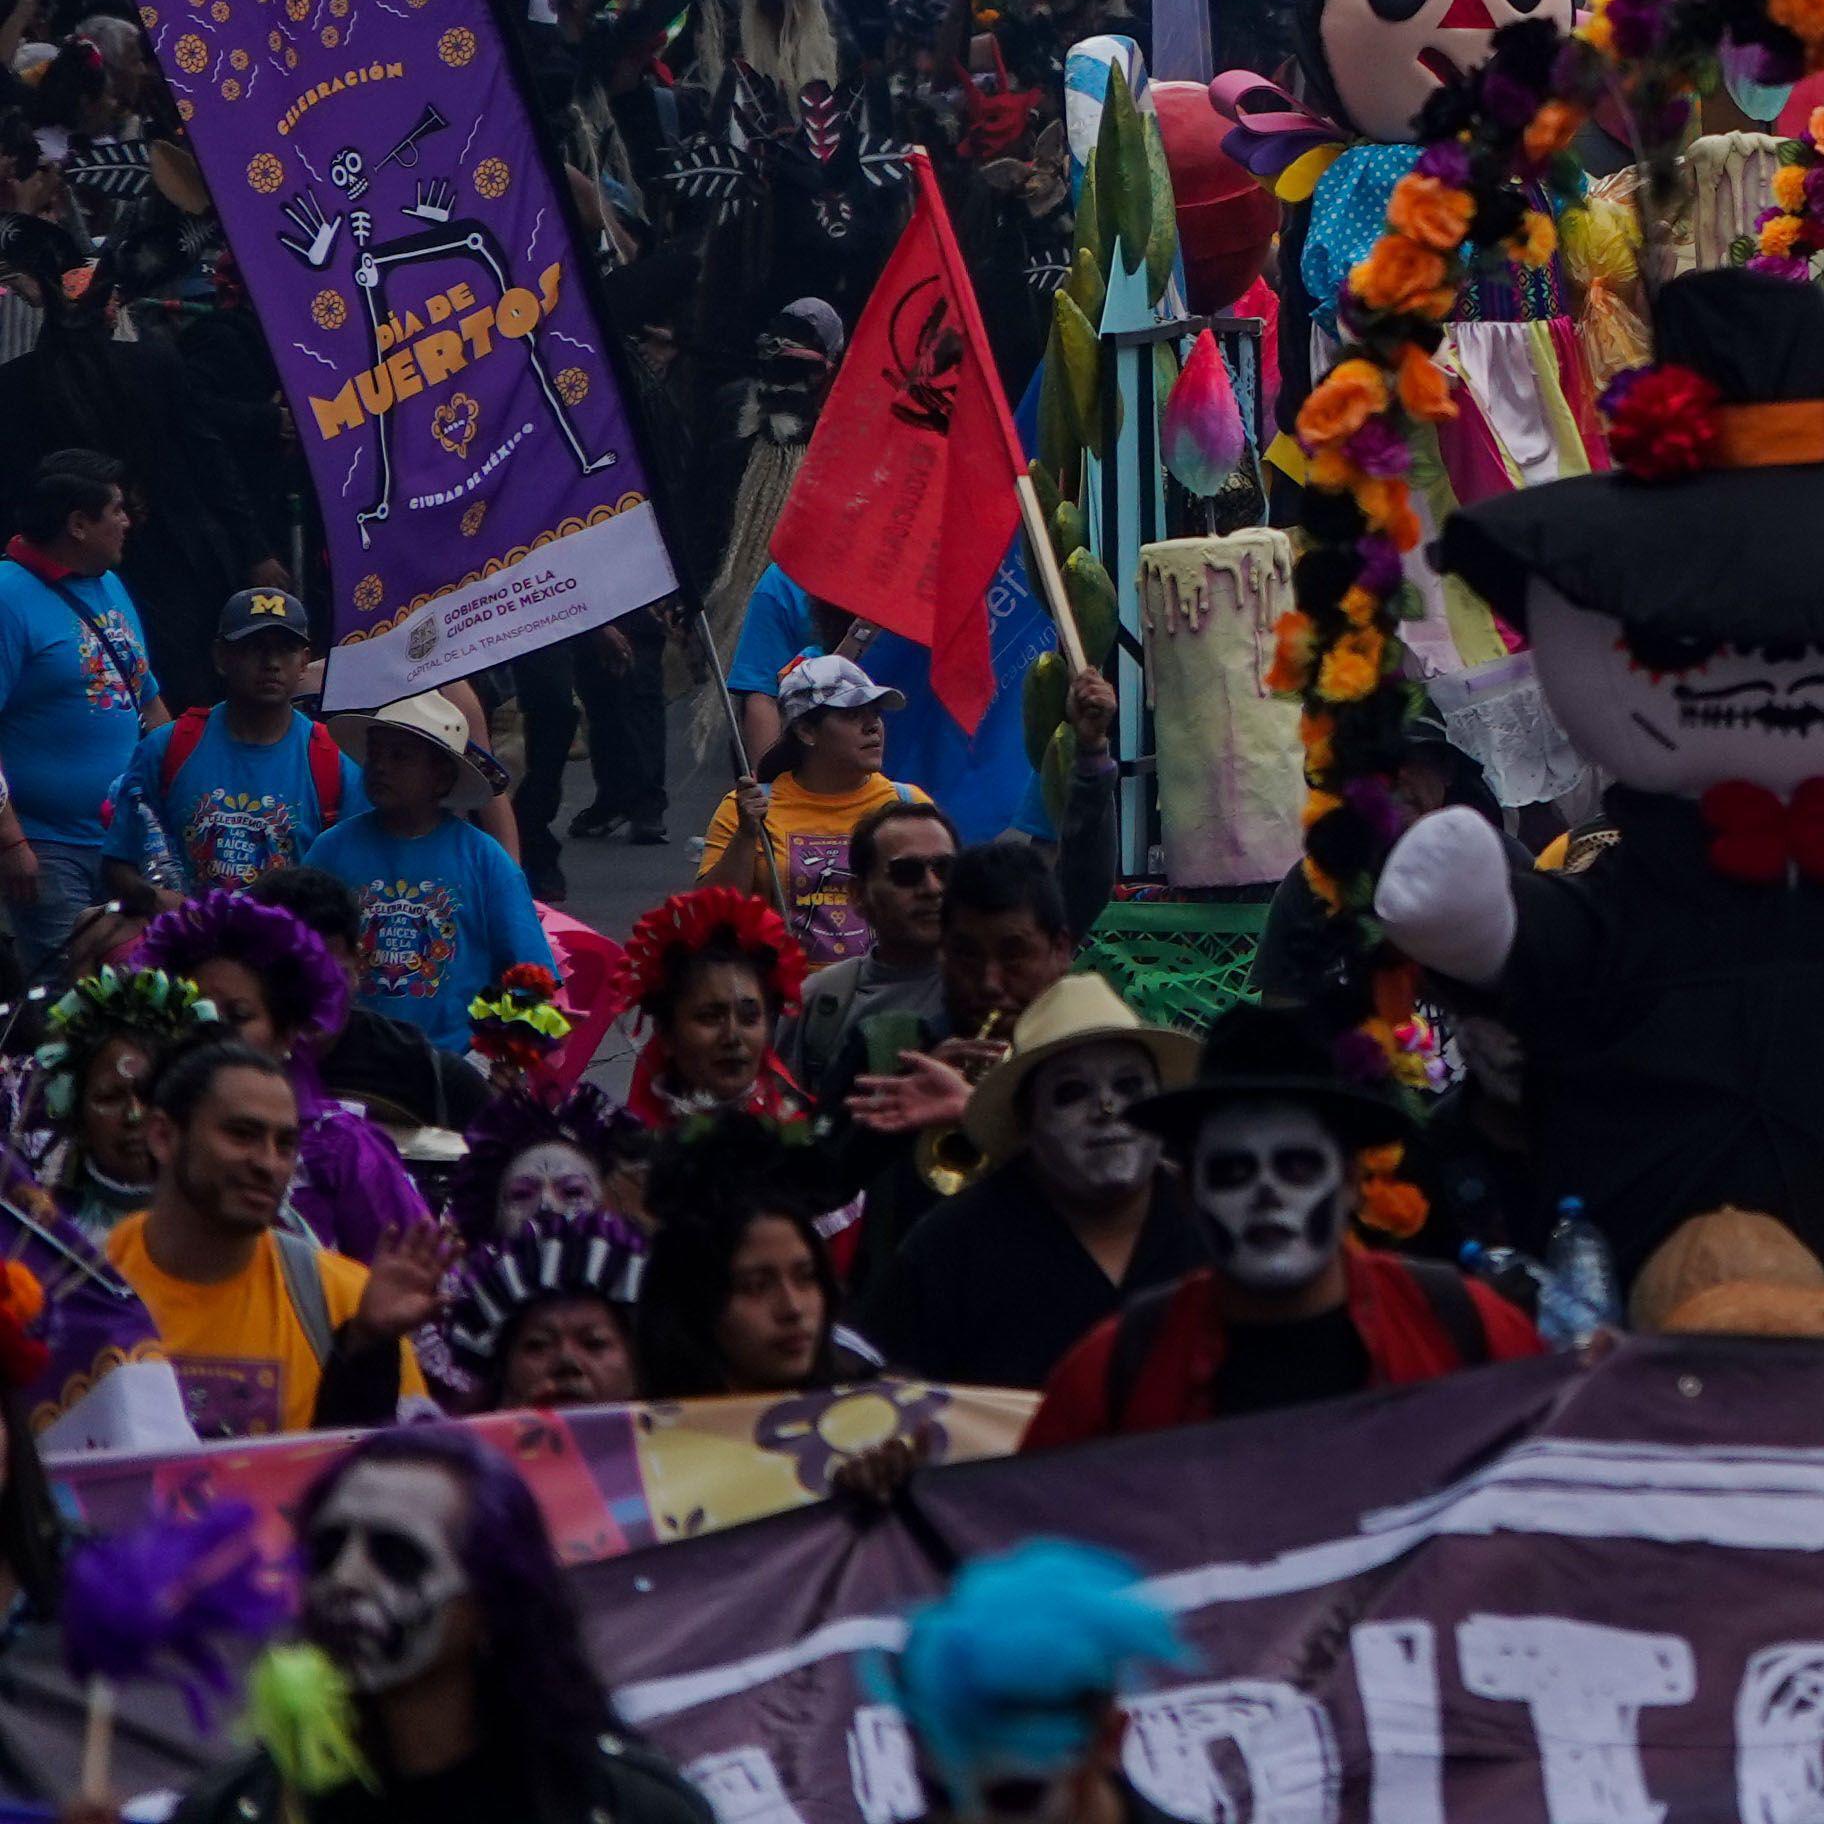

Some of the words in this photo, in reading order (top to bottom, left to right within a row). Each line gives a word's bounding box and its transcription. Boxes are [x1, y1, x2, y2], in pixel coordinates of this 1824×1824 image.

[374, 310, 425, 353] DÍA
[424, 281, 477, 325] DE
[308, 261, 562, 441] MUERTOS
[408, 484, 464, 510] CIUDAD
[465, 472, 484, 491] DE
[249, 593, 288, 618] M
[443, 587, 509, 625] GOBIERNO
[511, 576, 533, 594] DE
[535, 569, 556, 585] LA
[446, 608, 493, 639] CIUDAD
[496, 602, 516, 617] DE
[519, 577, 578, 608] MÉXICO
[406, 659, 443, 683] CAPITAL
[444, 648, 460, 663] DE
[460, 642, 478, 657] LA
[479, 602, 589, 649] TRANSFORMACIÓN
[385, 937, 398, 948] DE
